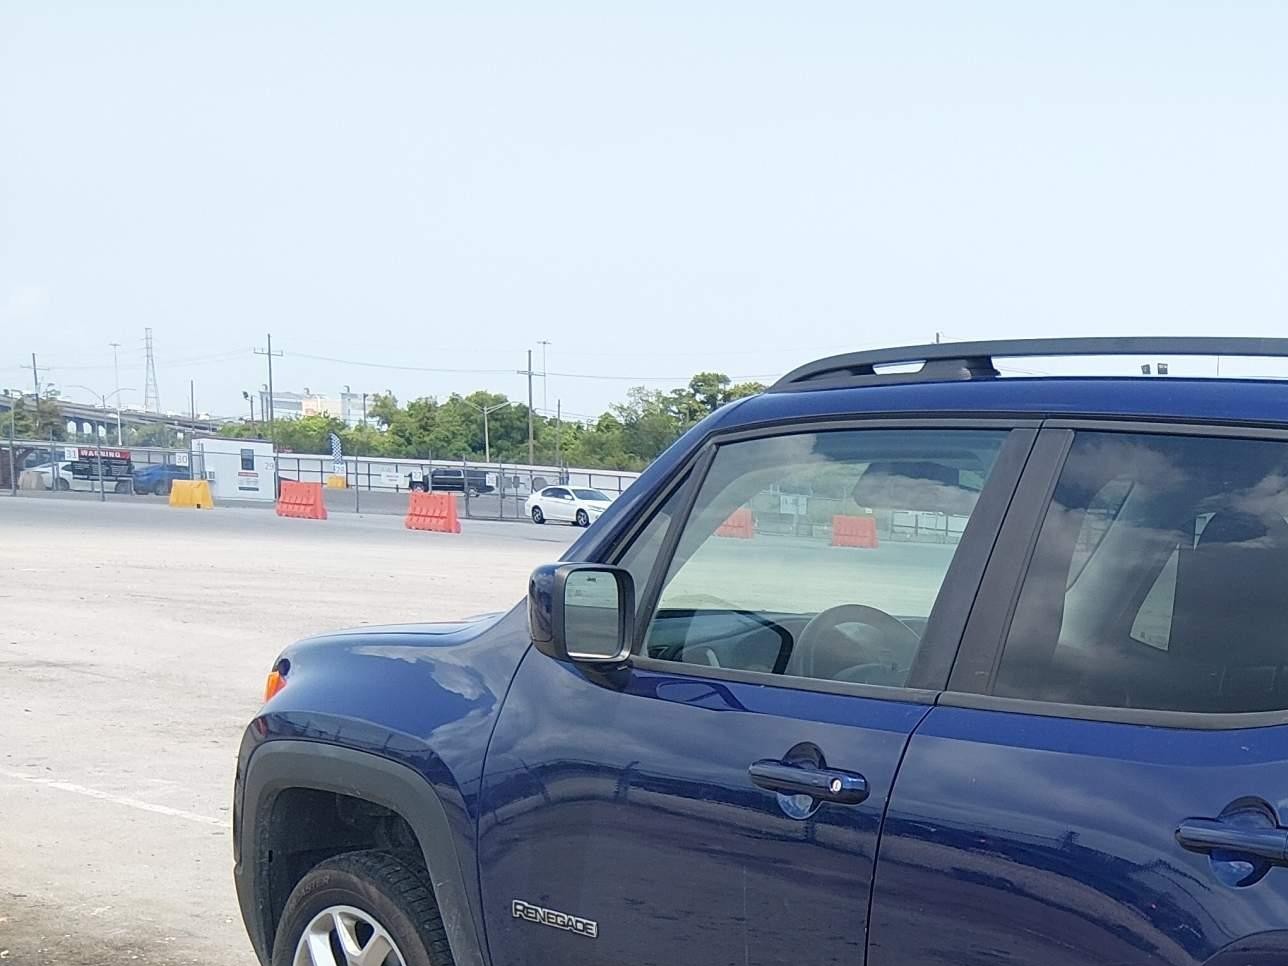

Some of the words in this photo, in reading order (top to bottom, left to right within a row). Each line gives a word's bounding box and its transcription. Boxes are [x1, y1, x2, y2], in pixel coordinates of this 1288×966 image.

[80, 449, 121, 458] WARNING
[176, 454, 187, 465] 30
[511, 898, 599, 938] RENEGADE
